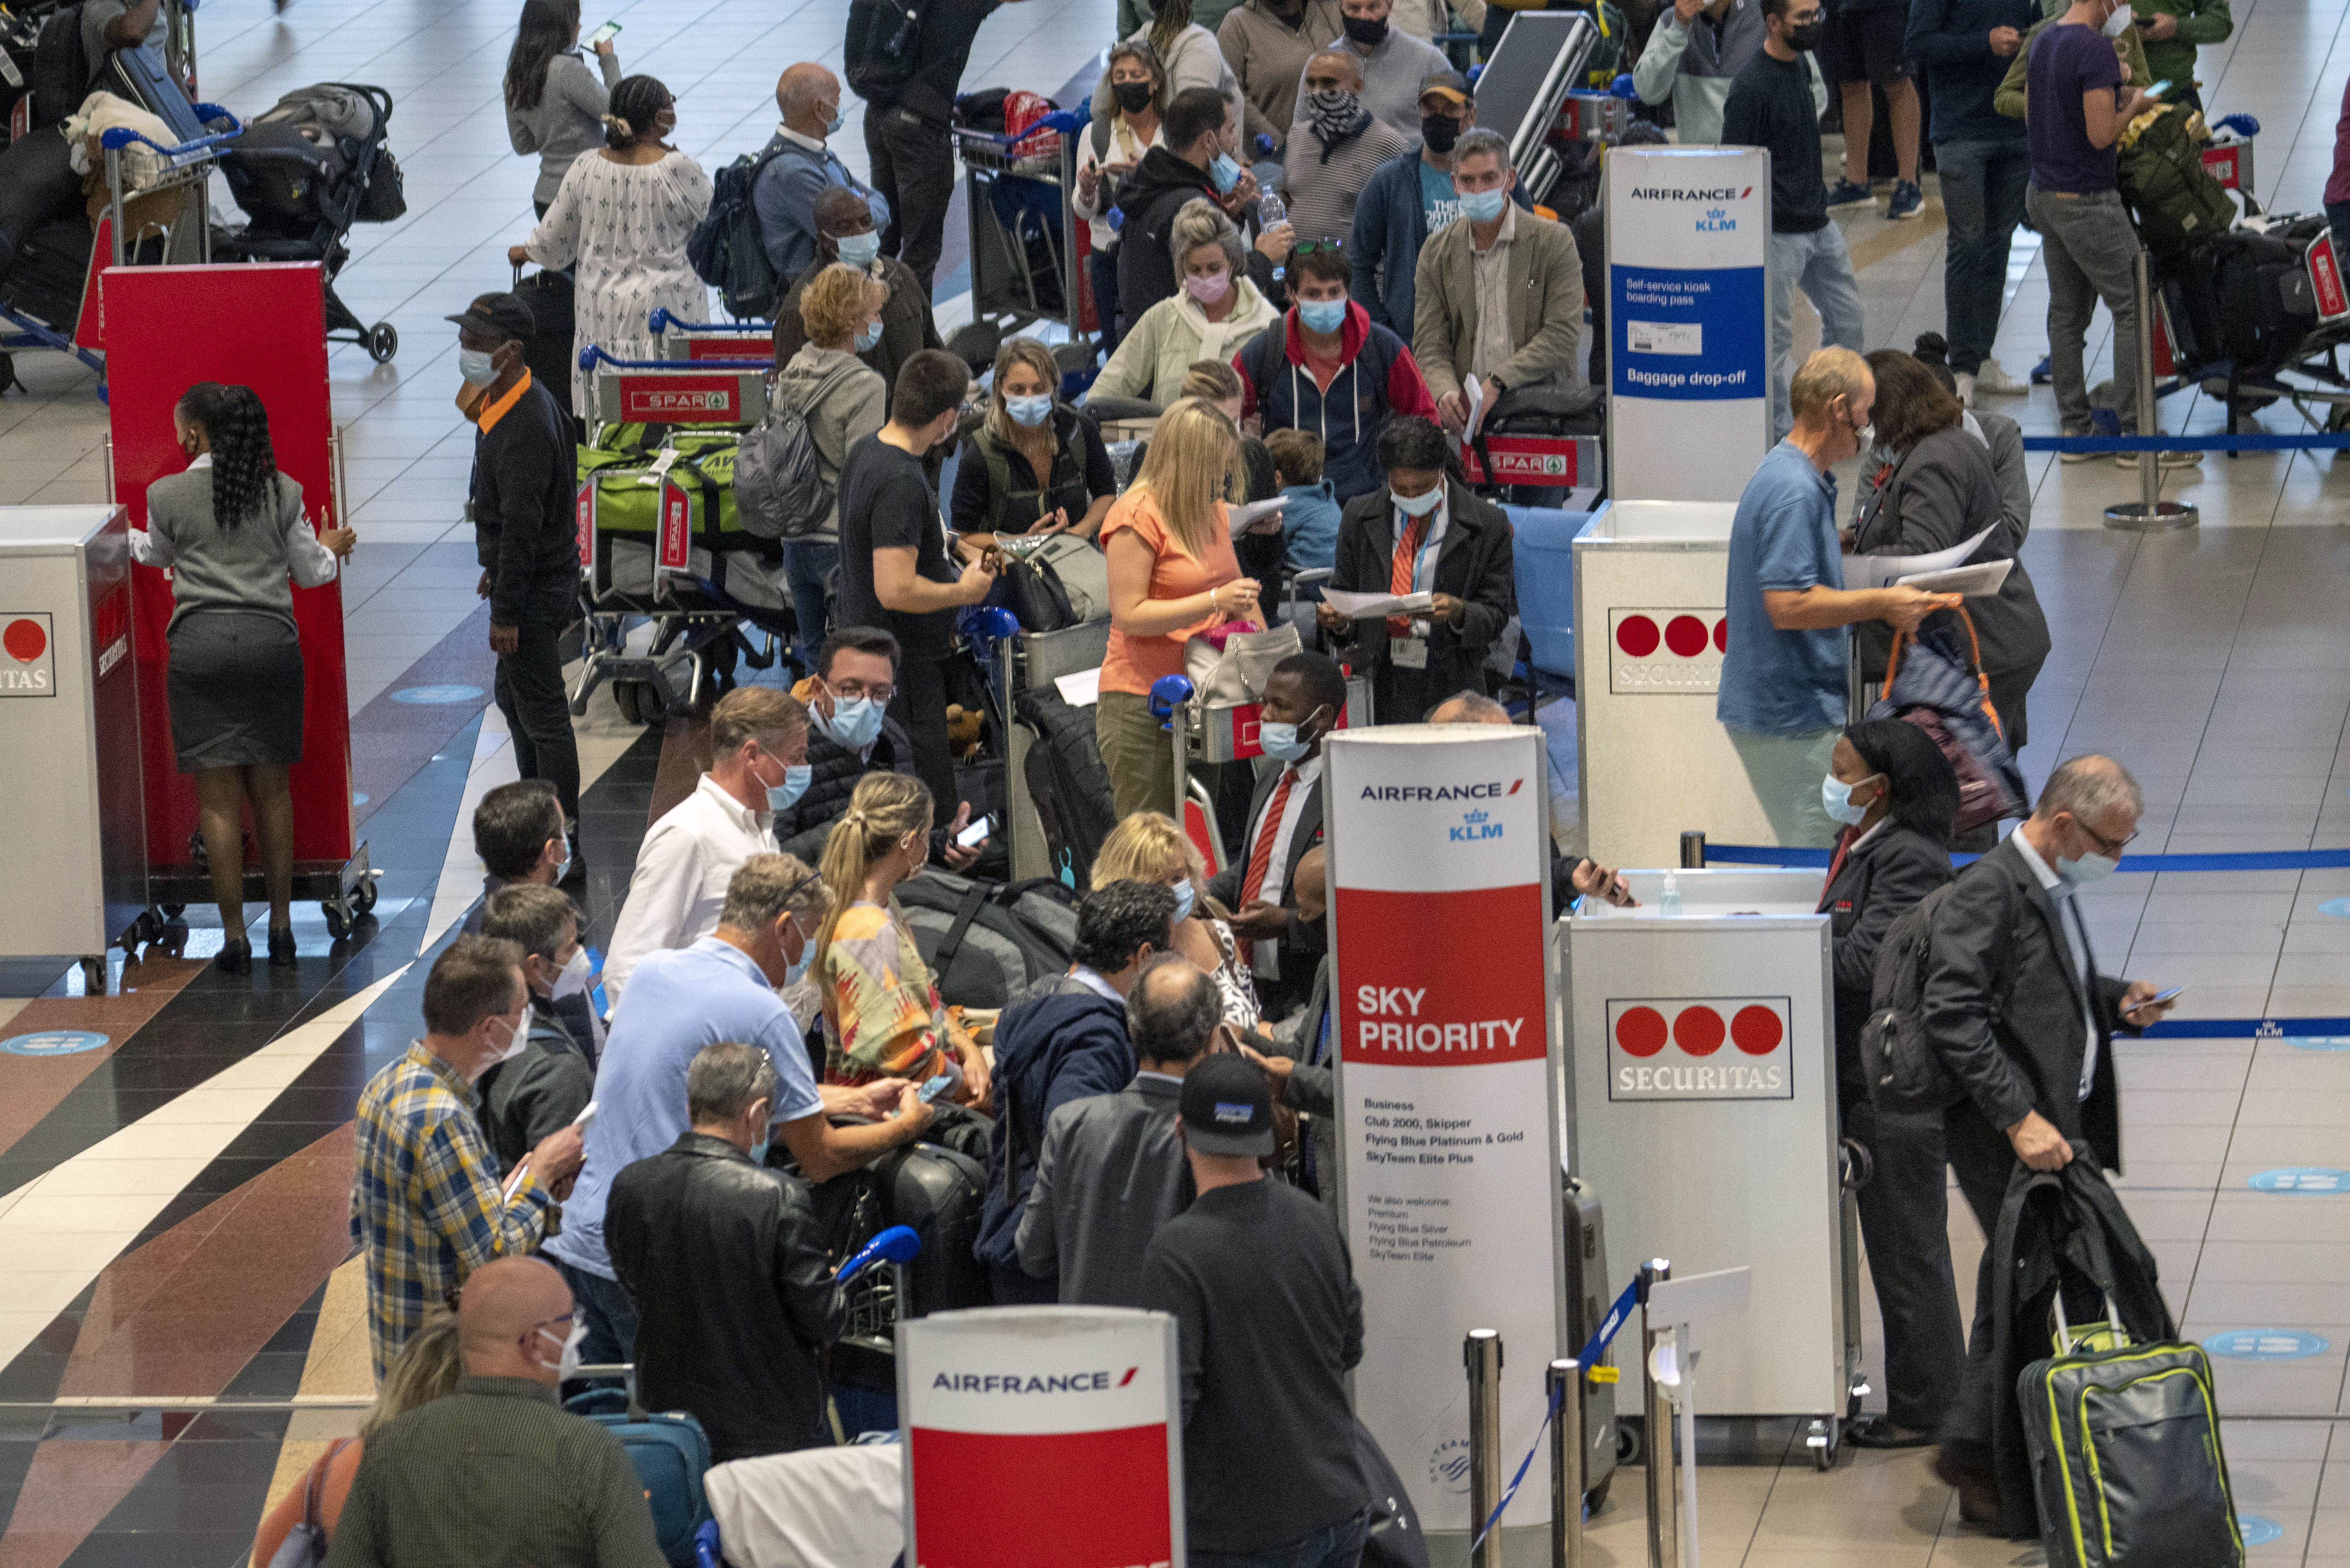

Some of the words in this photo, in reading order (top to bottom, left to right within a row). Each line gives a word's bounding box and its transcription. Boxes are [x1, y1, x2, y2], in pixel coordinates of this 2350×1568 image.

[1631, 187, 1736, 201] AIRFRANCE
[1696, 219, 1736, 232] KLM
[1627, 277, 1682, 292] Self-service
[1684, 281, 1711, 293] kiosk
[1627, 291, 1667, 307] boarding
[1670, 295, 1694, 307] pass
[1627, 367, 1686, 387] Baggage
[1689, 369, 1746, 387] drop-off
[649, 394, 704, 407] SPAR
[0, 669, 46, 689] TAS
[1361, 782, 1502, 801] AIRFRANCE
[1449, 823, 1503, 841] KLM
[1357, 984, 1426, 1016] SKY
[1359, 1017, 1525, 1053] PRIORITY
[1619, 1065, 1782, 1091] SECURITAS
[1364, 1097, 1414, 1111] Business
[1365, 1115, 1390, 1128] Club
[1392, 1117, 1423, 1130] 2000,
[1426, 1118, 1472, 1131] Skipper
[1366, 1132, 1398, 1147] Flying
[1401, 1135, 1426, 1146] Blue
[1430, 1135, 1482, 1146] Platinum
[1485, 1133, 1494, 1145] &
[1497, 1130, 1524, 1143] Gold
[1366, 1150, 1416, 1164] SkyTeam
[1419, 1153, 1445, 1164] Elite
[1448, 1152, 1474, 1164] Plus
[1368, 1194, 1382, 1204] We
[1384, 1196, 1403, 1206] also
[1368, 1207, 1409, 1219] Premium
[1369, 1221, 1395, 1234] Flying
[1397, 1224, 1419, 1234] Blue
[1421, 1224, 1449, 1234] Silver
[1369, 1235, 1396, 1248] Flying
[1398, 1237, 1419, 1247] Blue
[1413, 1251, 1434, 1261] Elite
[932, 1371, 1110, 1394] AIRFRANCE
